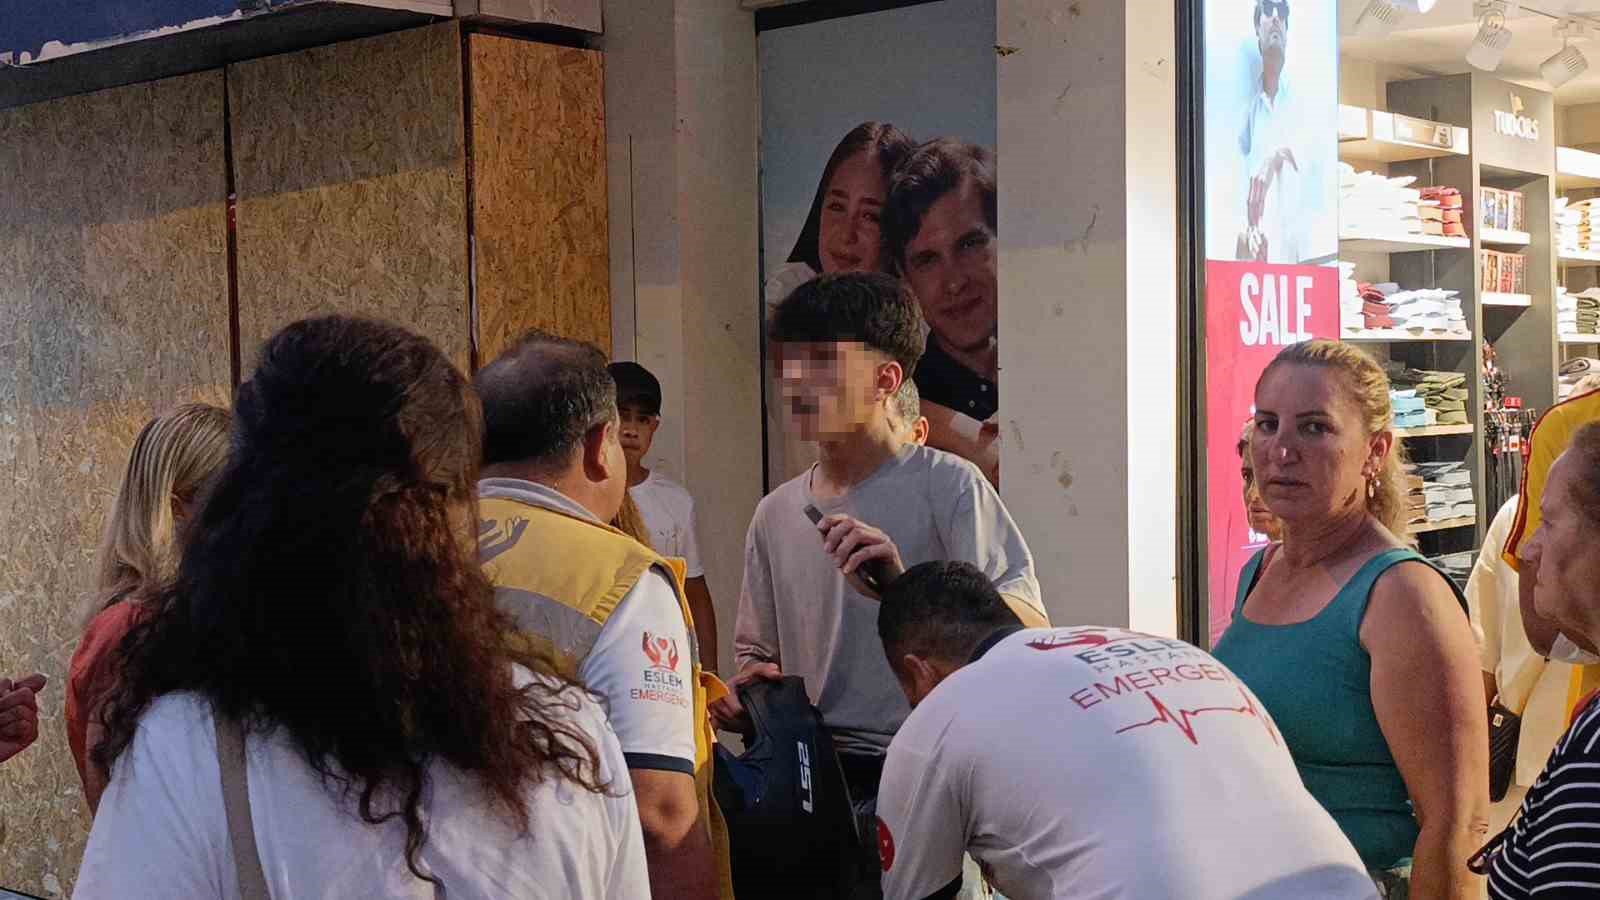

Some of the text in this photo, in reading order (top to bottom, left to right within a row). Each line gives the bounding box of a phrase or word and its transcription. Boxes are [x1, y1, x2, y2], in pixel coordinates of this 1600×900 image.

[1494, 109, 1539, 140] TUDORS
[1239, 273, 1312, 346] SALE
[1074, 639, 1188, 665] ESLE
[797, 741, 814, 814] LS2
